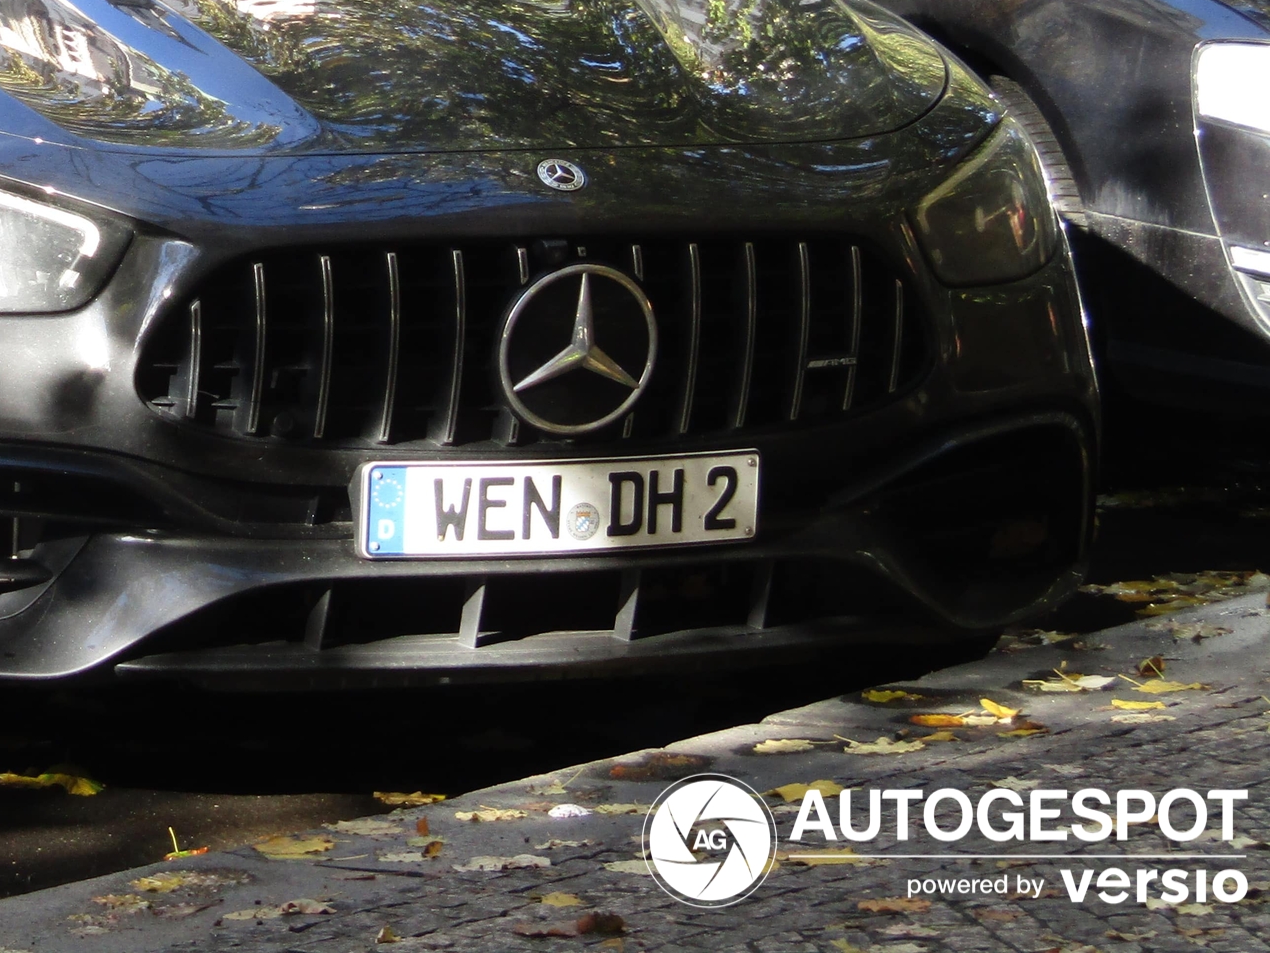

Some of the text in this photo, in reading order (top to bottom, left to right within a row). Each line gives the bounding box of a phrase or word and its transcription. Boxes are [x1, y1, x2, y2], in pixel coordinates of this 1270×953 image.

[434, 474, 562, 541] WEN
[606, 468, 684, 537] DH
[704, 465, 738, 531] 2
[377, 519, 395, 539] D
